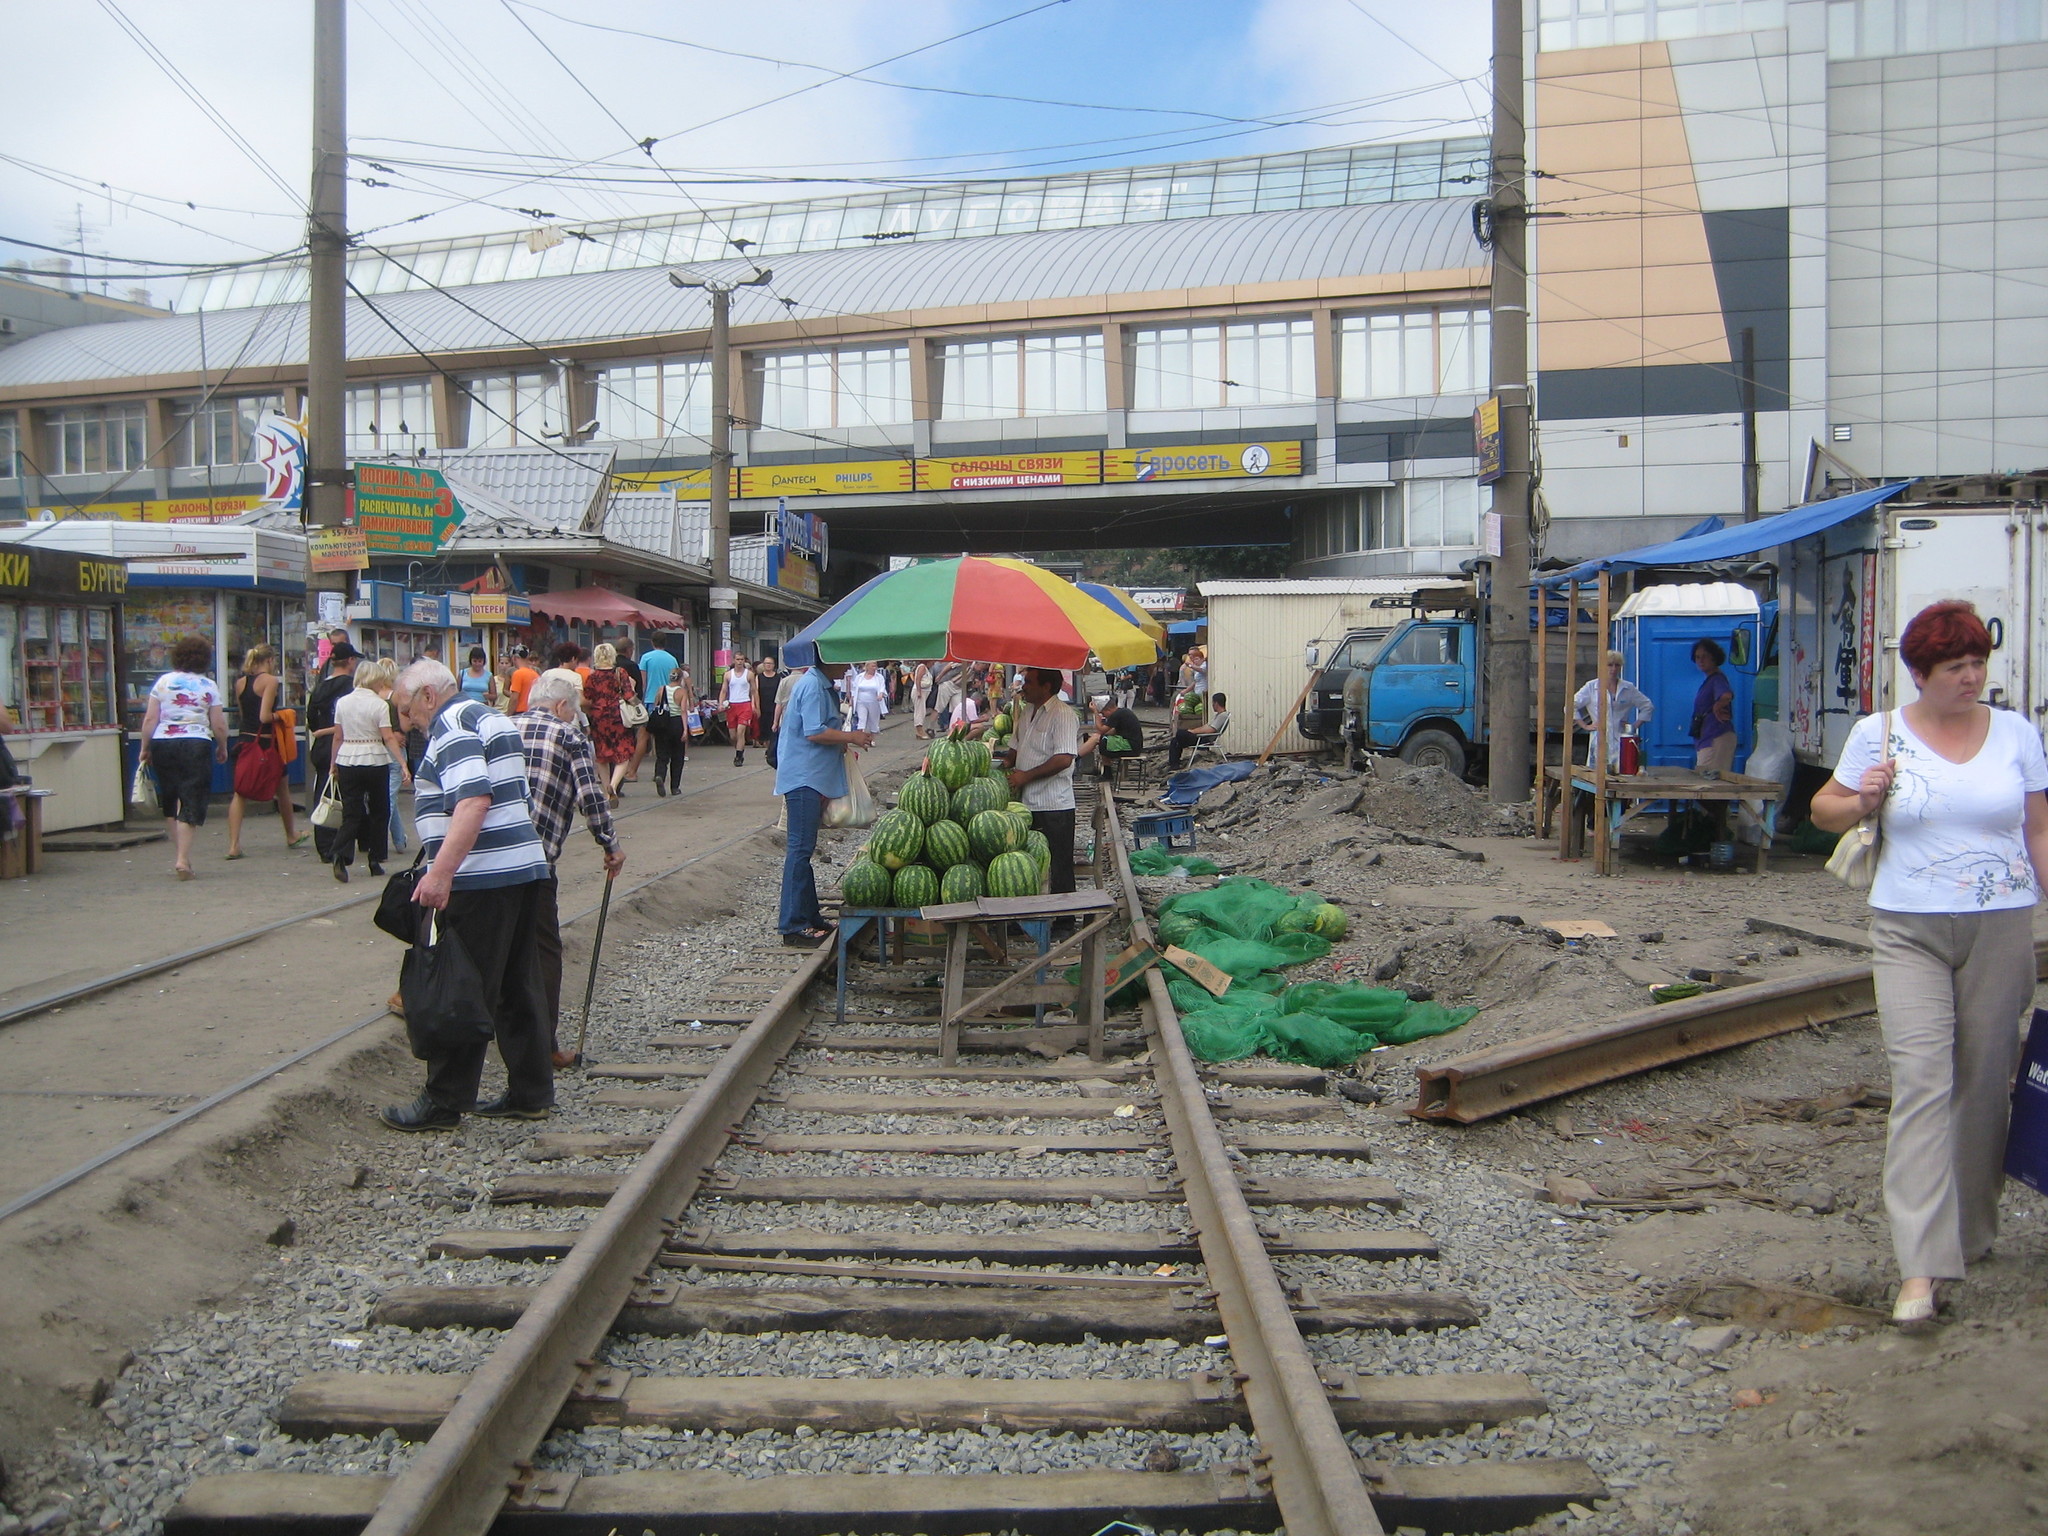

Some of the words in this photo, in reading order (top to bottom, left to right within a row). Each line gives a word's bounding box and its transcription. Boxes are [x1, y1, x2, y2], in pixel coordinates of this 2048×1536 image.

[951, 458, 1013, 473] САЛОНЫ
[1017, 457, 1063, 471] СВЯЗИ
[360, 467, 399, 485] КОПИИ
[772, 475, 816, 488] PANTECH
[835, 473, 872, 482] PHILIPS
[953, 478, 960, 487] С
[962, 476, 1014, 486] НИЗКИМИ
[1016, 474, 1061, 485] ЦЕНАМИ
[215, 501, 246, 511] СВЯЗИ
[360, 499, 410, 515] РАСПЕЧАТКА
[434, 487, 454, 517] 3
[174, 543, 197, 553] Лиза
[310, 541, 366, 551] компьютерная
[321, 549, 367, 558] мастерская
[79, 560, 129, 595] БУРГЕР
[158, 565, 212, 576] ИНТЕРЬЕР
